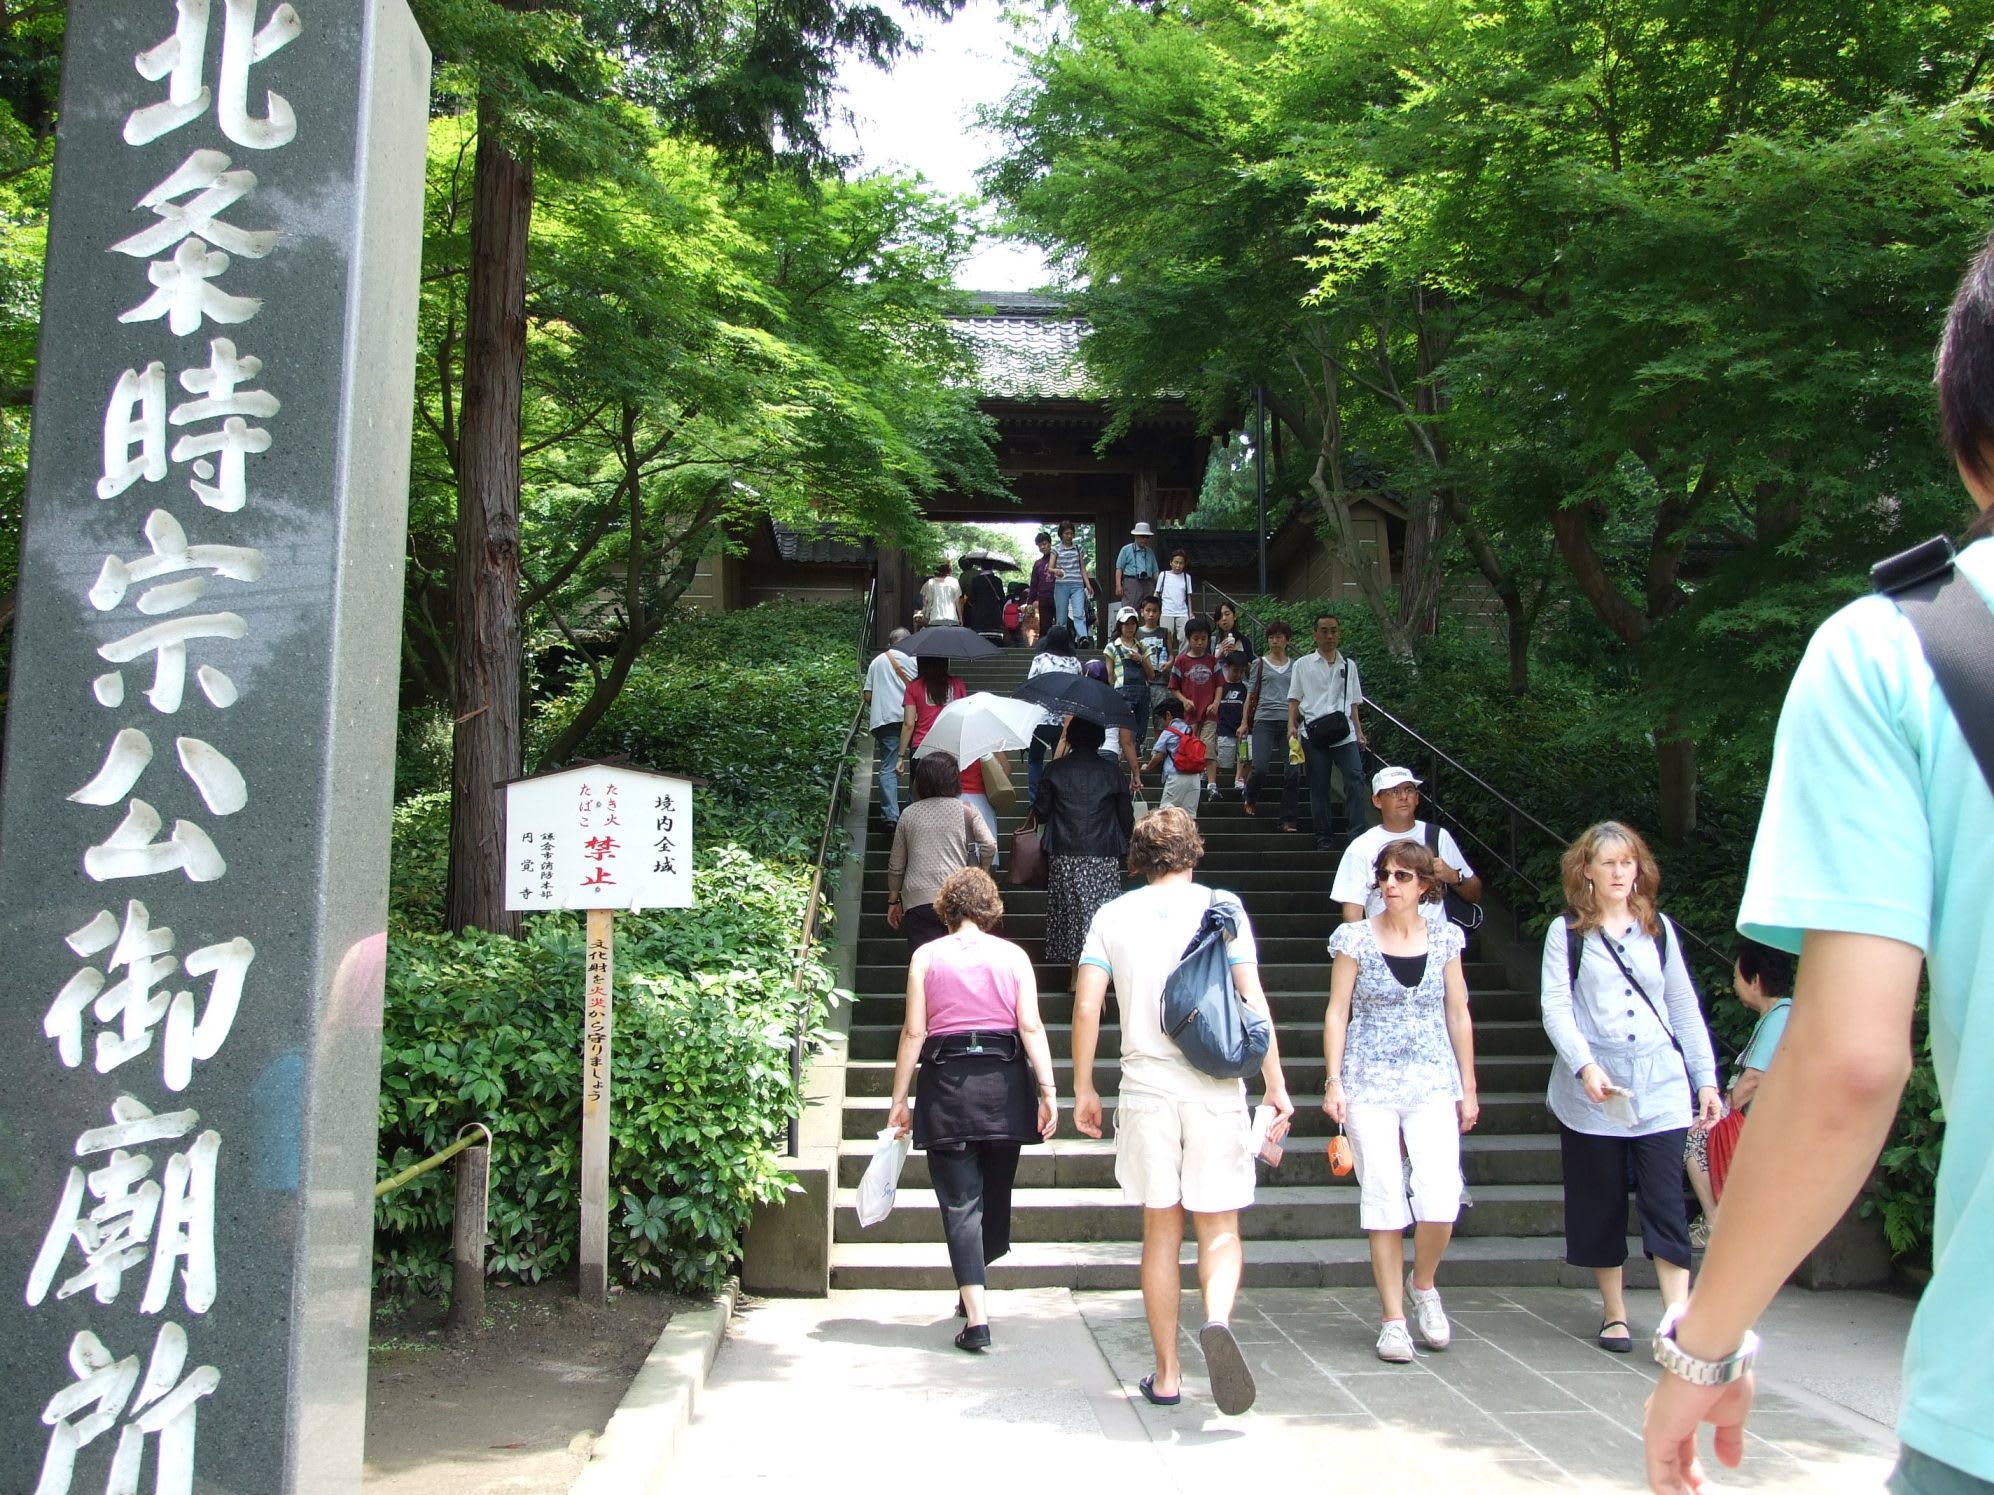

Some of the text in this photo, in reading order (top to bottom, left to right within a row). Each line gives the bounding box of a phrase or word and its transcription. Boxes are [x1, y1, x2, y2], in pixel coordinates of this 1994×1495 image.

[579, 783, 593, 828] たばこ
[604, 783, 621, 826] たき火
[653, 794, 677, 875] 境内全域
[519, 832, 535, 900] 円覚寺
[580, 835, 622, 887] 禁止
[587, 939, 609, 1102] 文化財を火災から守りましょう
